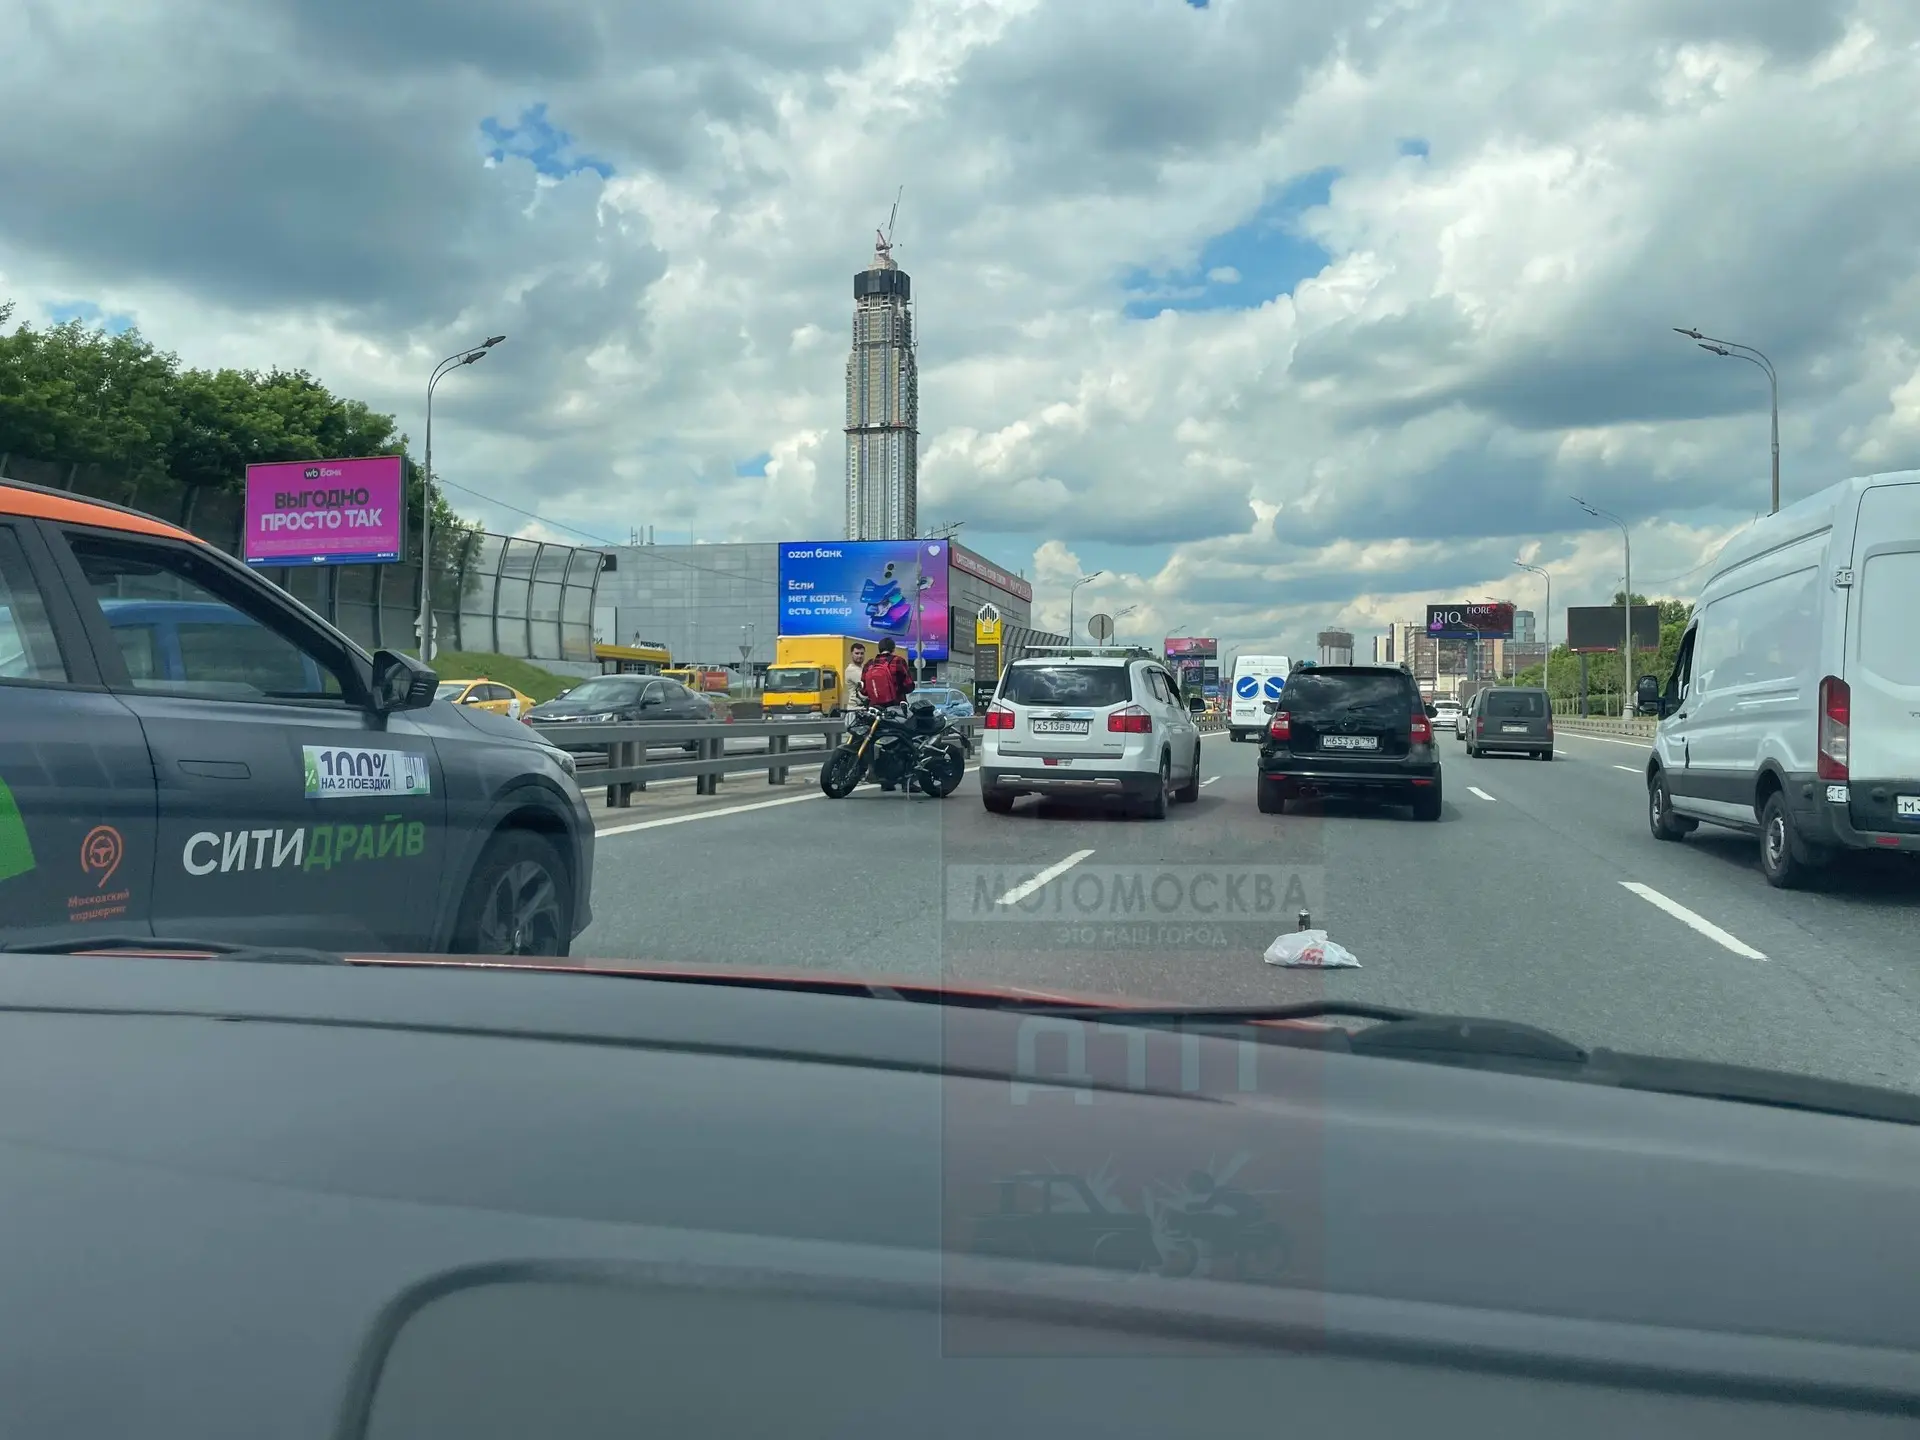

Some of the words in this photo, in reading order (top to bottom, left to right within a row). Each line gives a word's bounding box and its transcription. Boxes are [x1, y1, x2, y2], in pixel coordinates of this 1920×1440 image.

[274, 487, 370, 510] ВЫГОДНО
[260, 510, 342, 531] ПРОСТО
[344, 508, 383, 528] ТАК
[788, 550, 814, 559] ozon
[816, 548, 842, 559] банк
[788, 580, 814, 590] Если
[788, 594, 807, 603] нет
[809, 594, 847, 604] карты,
[788, 607, 812, 615] есть
[814, 606, 852, 617] стикер
[1466, 606, 1490, 614] FIORE
[321, 777, 335, 789] НА
[338, 778, 345, 789] 2
[347, 778, 391, 792] ПОЕЗДКИ
[183, 814, 425, 876] СИТИДРАЙВ
[68, 888, 130, 908] Московский
